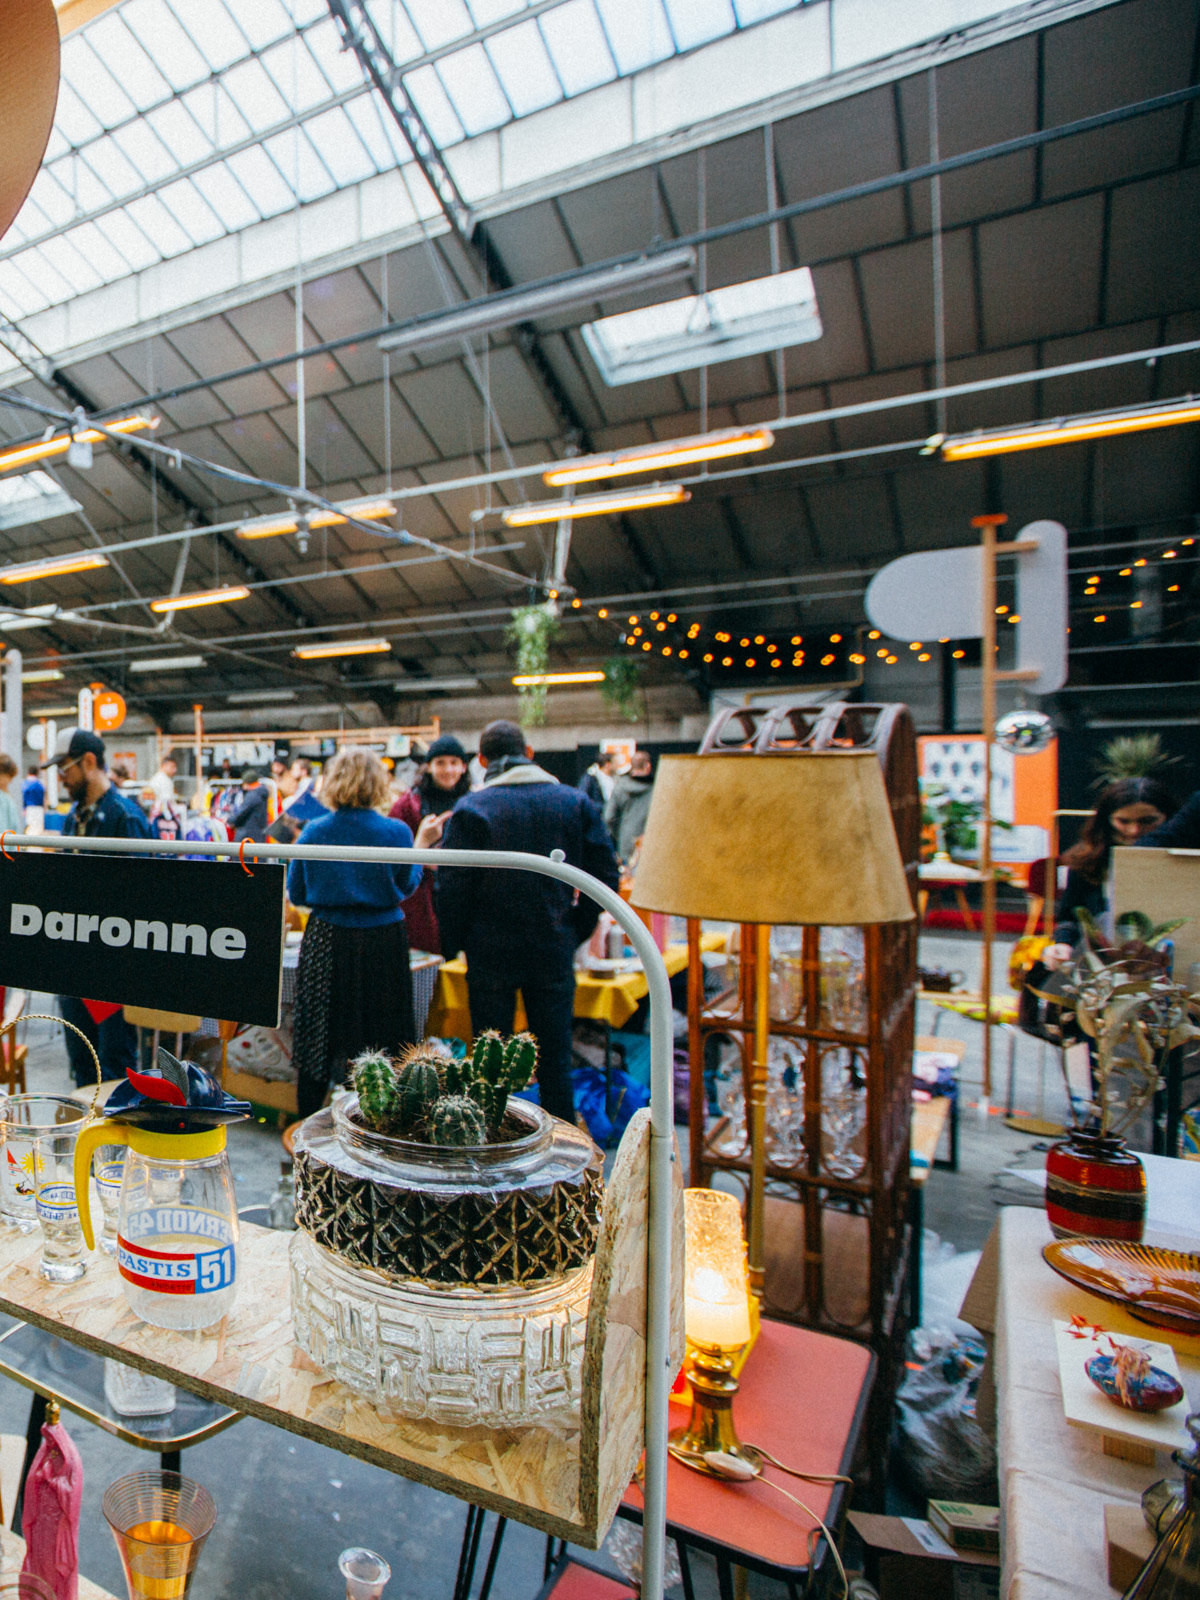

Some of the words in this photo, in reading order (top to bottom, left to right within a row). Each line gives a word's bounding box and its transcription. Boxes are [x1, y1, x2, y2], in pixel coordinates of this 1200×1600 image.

[9, 902, 247, 960] Daronne
[118, 1249, 191, 1278] PASTIS
[200, 1249, 231, 1289] 51
